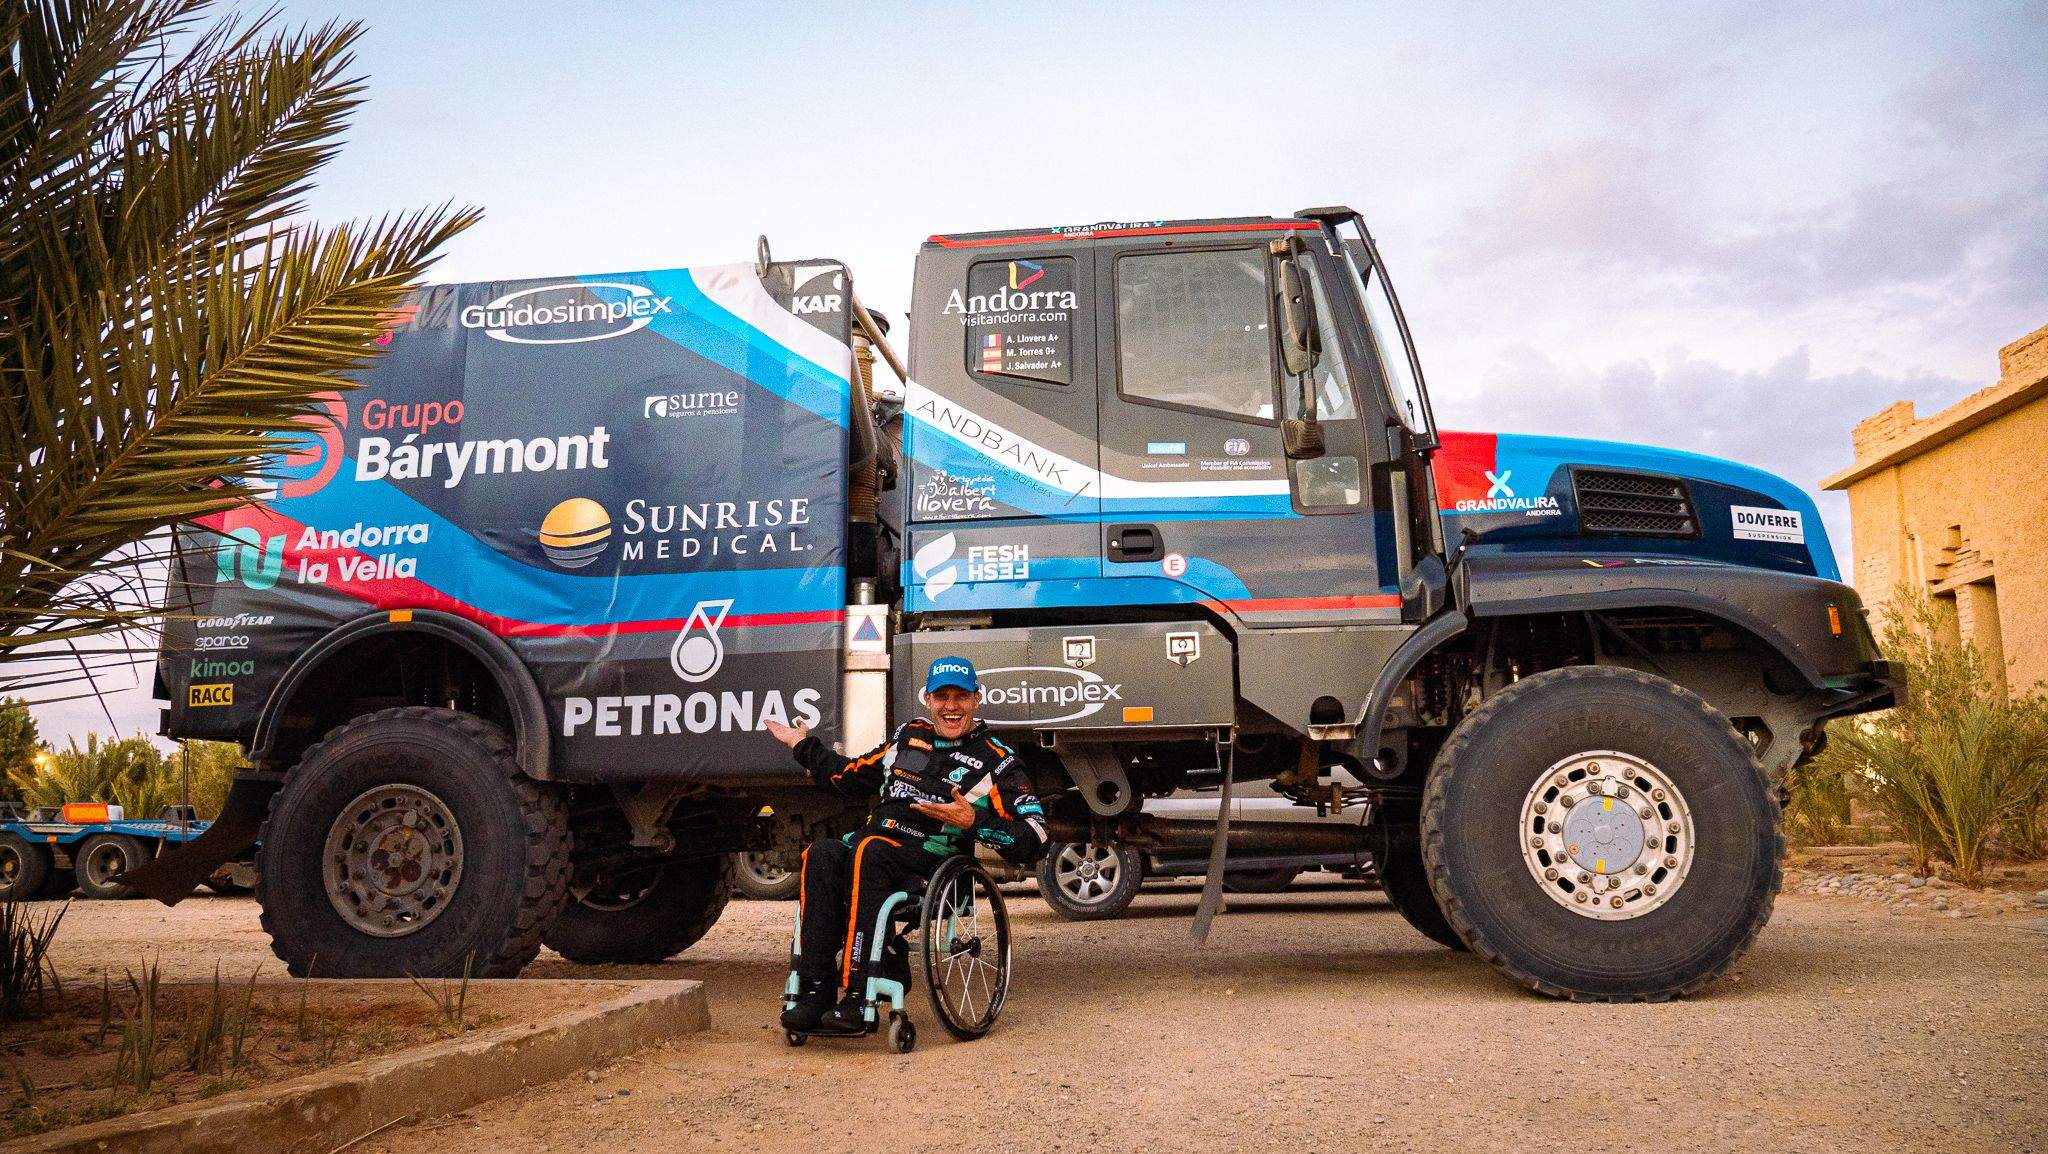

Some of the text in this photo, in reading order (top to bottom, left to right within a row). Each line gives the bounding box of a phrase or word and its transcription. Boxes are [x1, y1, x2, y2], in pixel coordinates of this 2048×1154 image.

[792, 294, 841, 314] KAR
[942, 286, 1079, 315] Andorra
[460, 295, 673, 329] Guidosimplex
[960, 312, 1067, 327] visitandorra.com
[1006, 333, 1059, 343] A. Llovera A+
[1006, 348, 1017, 357] M.
[1018, 348, 1044, 356] Torres
[1015, 361, 1048, 370] Salvador
[1050, 360, 1062, 368] A+
[669, 391, 739, 410] surne
[362, 399, 465, 434] Grupo
[703, 408, 738, 417] pensiones
[916, 400, 1068, 485] ANDBANK
[1226, 441, 1247, 453] FIA
[355, 426, 611, 488] Bárymont
[975, 451, 1011, 476] Private
[949, 484, 997, 496] albert
[916, 494, 997, 512] llovera
[1455, 496, 1559, 512] GRANDVALIRA
[1525, 508, 1562, 517] ANDORRA
[1737, 512, 1798, 529] DONERRE
[295, 521, 429, 551] Andorra
[1748, 532, 1792, 541] SUSPENSION
[968, 544, 1029, 563] FESH
[298, 553, 417, 585] la Vella
[197, 612, 275, 629] GOODYEAR
[195, 634, 250, 652] sparco
[190, 657, 255, 678] kimoa
[932, 662, 969, 676] kimoa
[191, 686, 232, 704] RACC
[563, 687, 822, 737] PETRONAS
